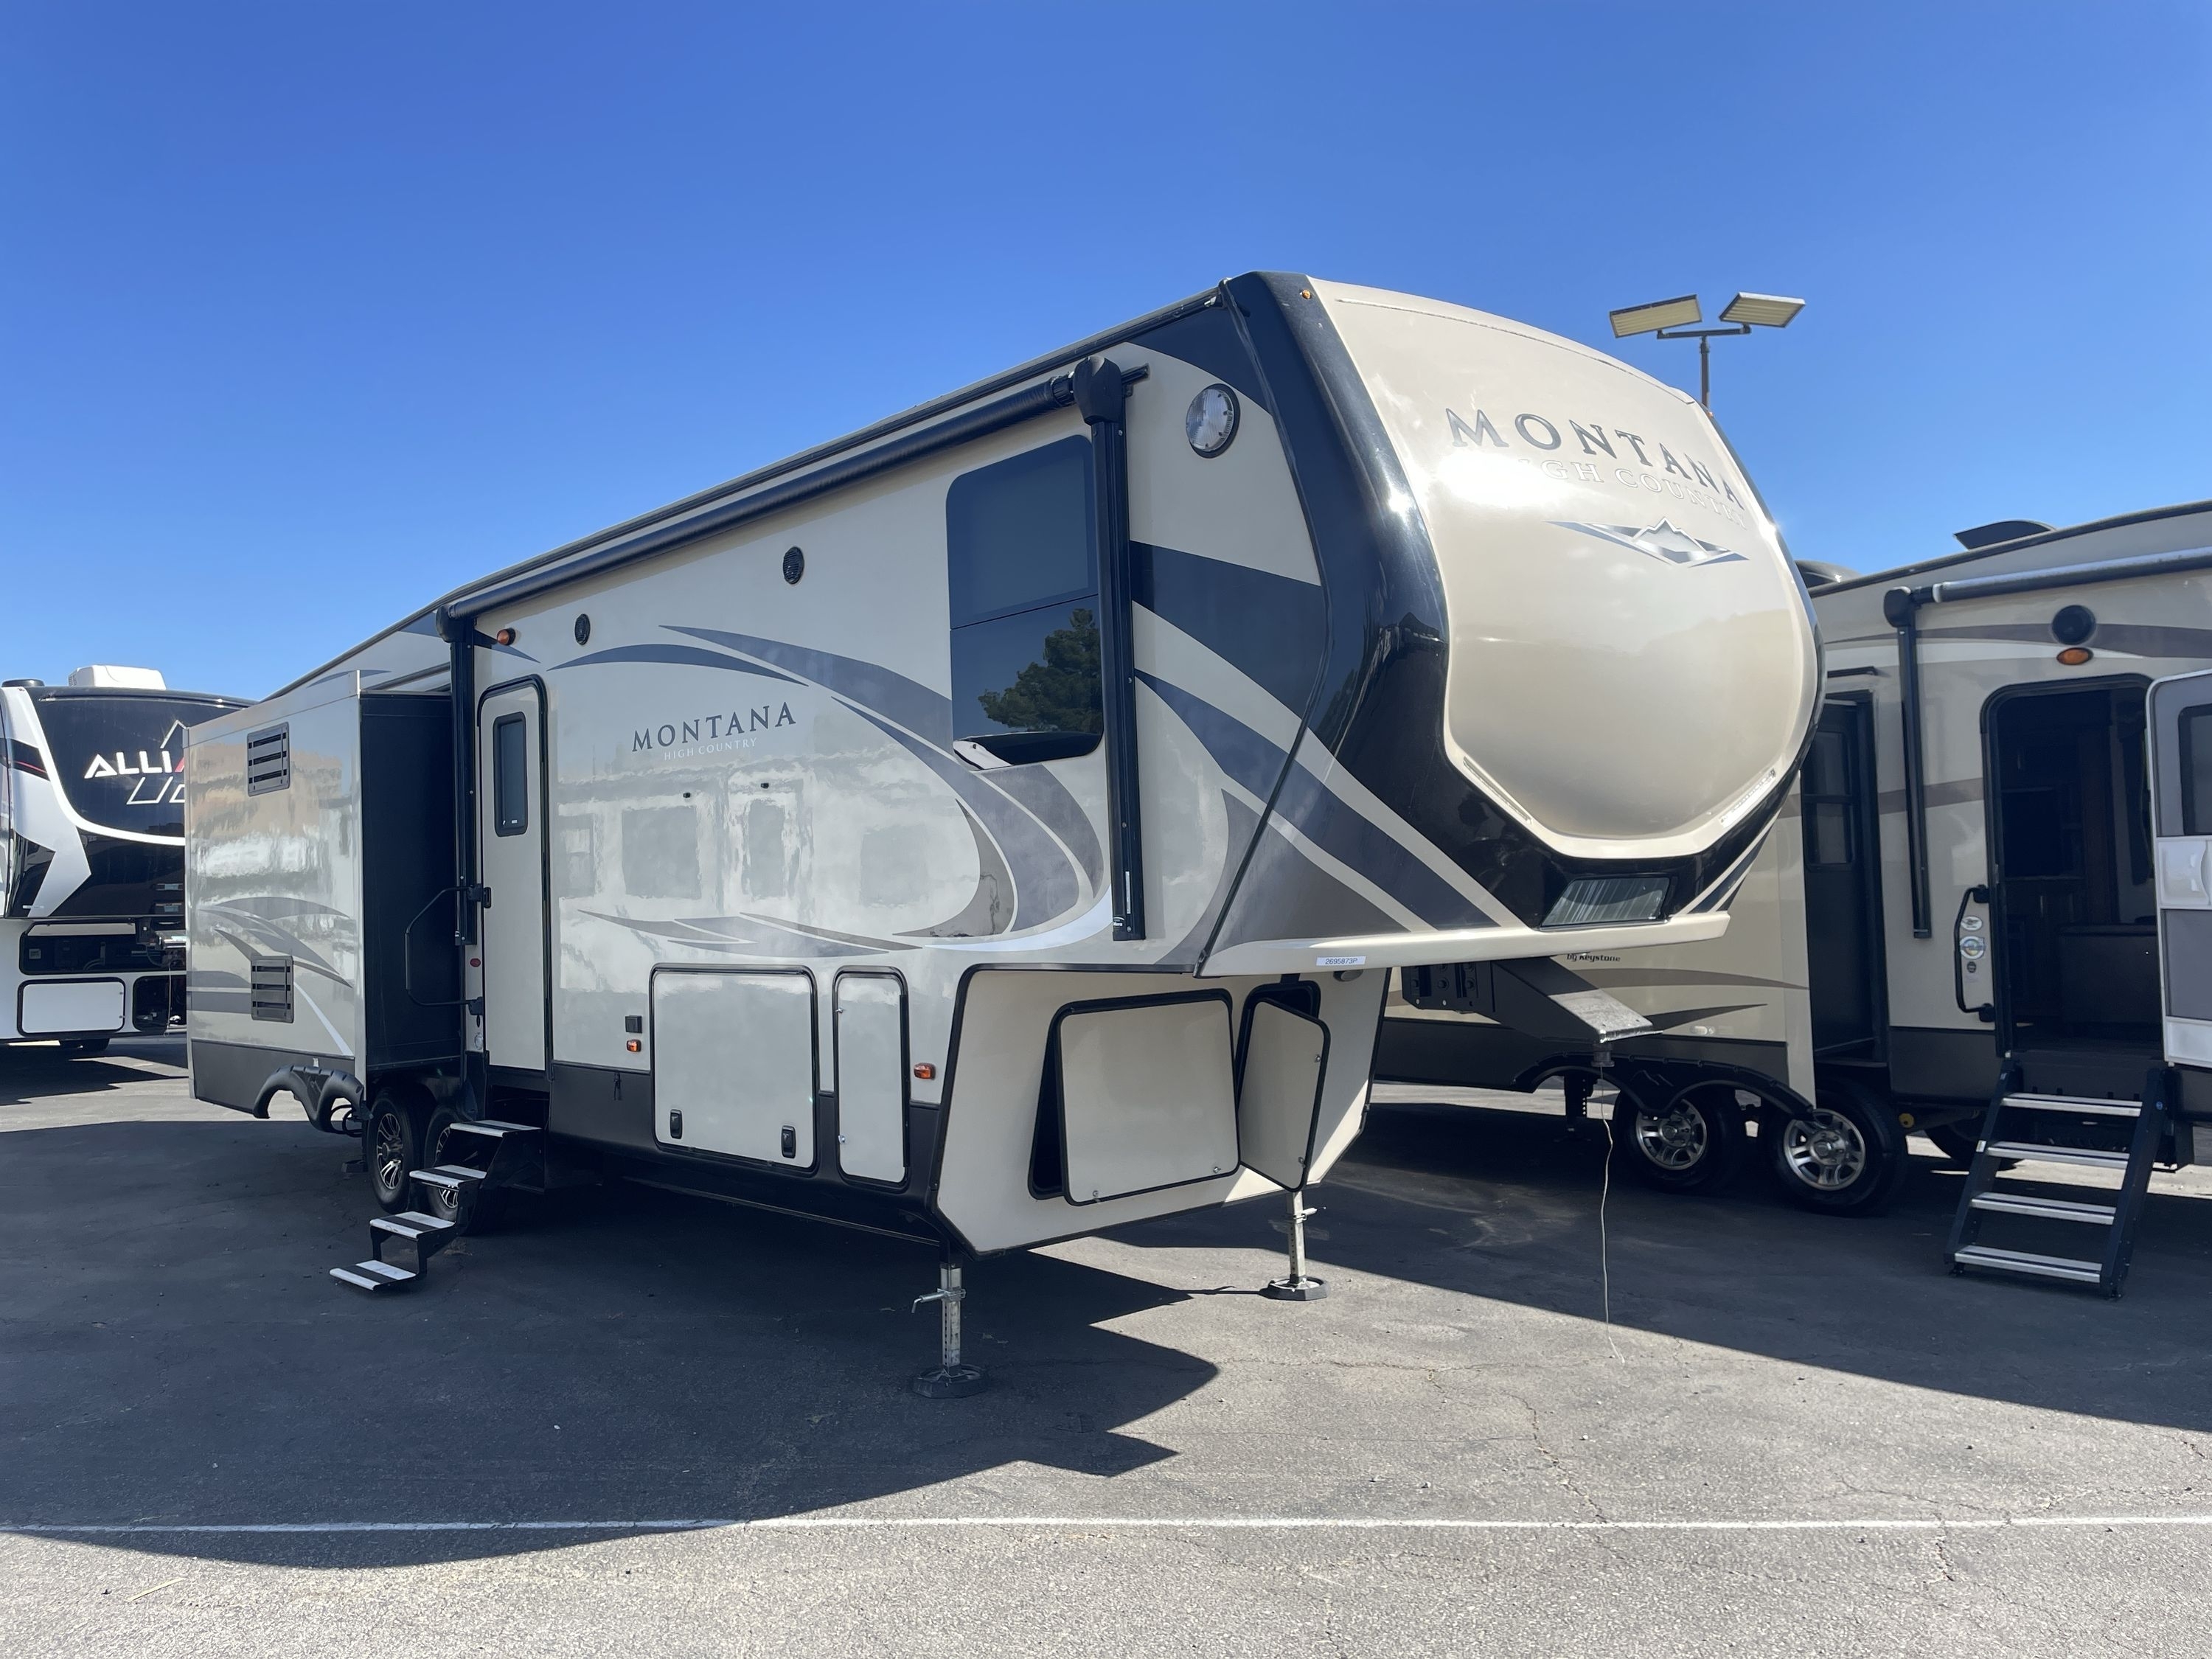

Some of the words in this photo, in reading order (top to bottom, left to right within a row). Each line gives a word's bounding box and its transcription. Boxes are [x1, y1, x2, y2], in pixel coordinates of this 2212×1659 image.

[1445, 408, 1745, 510] MONTANA
[1518, 459, 1605, 484] GH
[1614, 467, 1747, 530] COUNTRY
[632, 701, 796, 752] MONTANA
[664, 747, 694, 761] HIGH
[698, 737, 757, 755] COUNTRY
[1567, 953, 1577, 961] by
